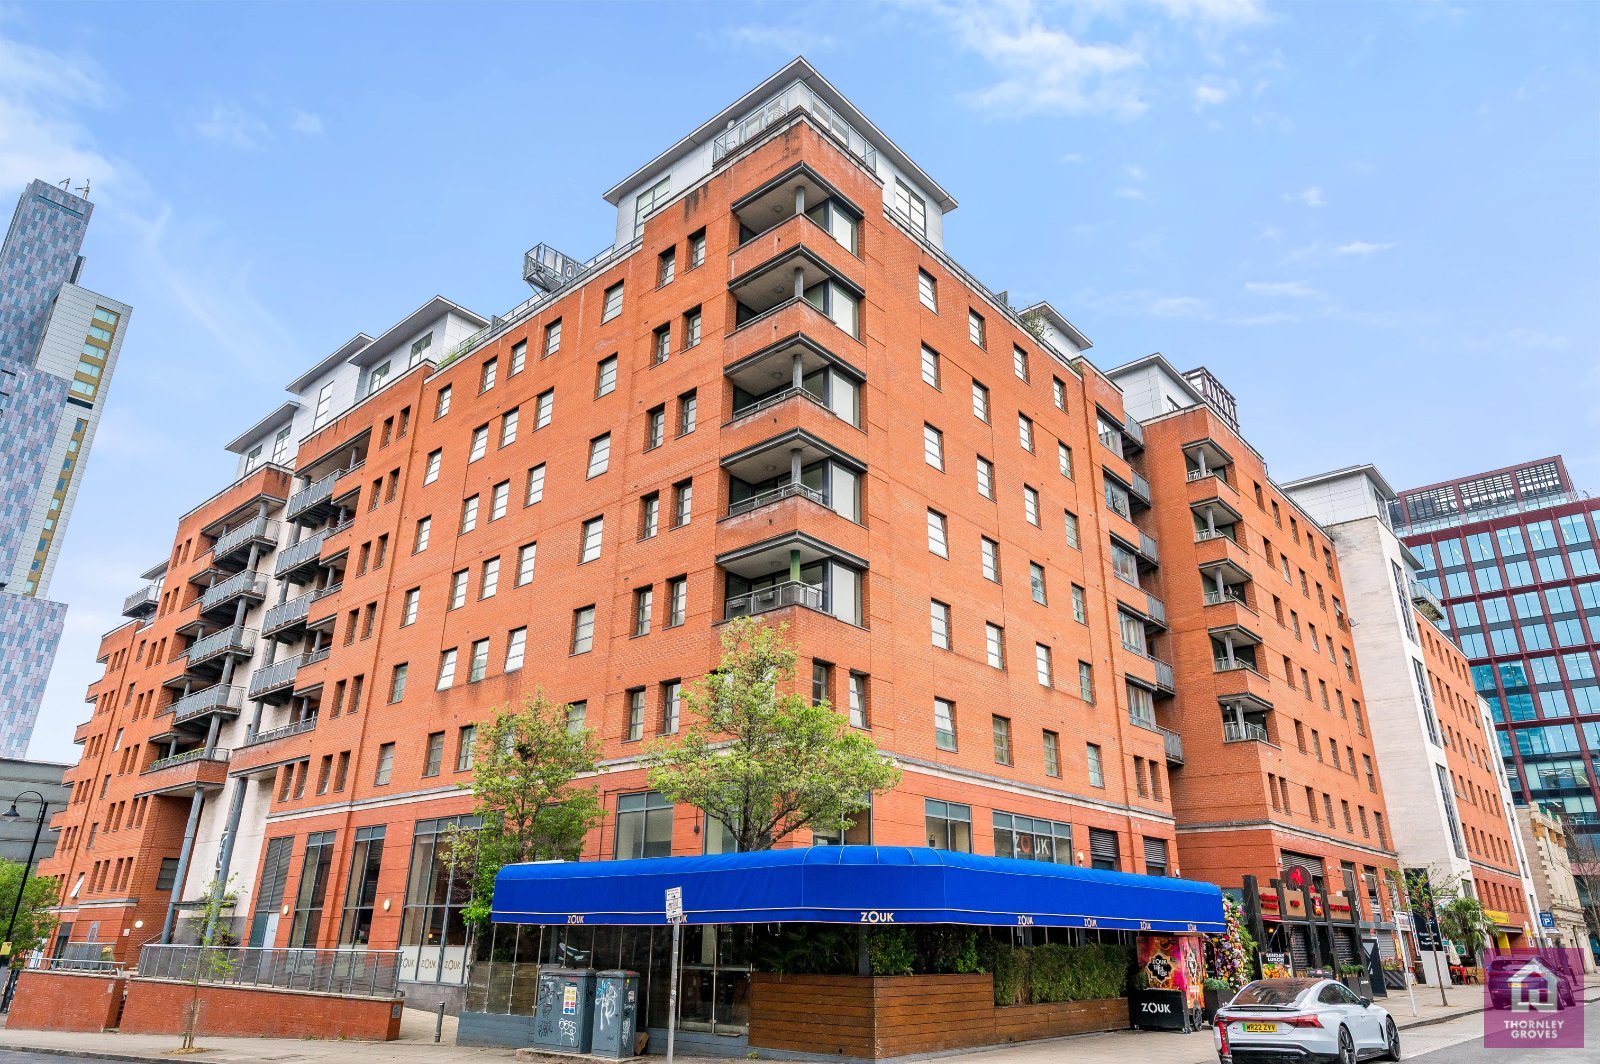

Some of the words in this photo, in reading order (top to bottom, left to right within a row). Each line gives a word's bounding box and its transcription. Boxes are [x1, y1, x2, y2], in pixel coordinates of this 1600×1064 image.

[1014, 834, 1051, 855] ZOUK
[567, 915, 584, 923] ZOUK
[860, 911, 895, 923] ZOUK
[1017, 915, 1033, 925] ZOUK
[1083, 917, 1098, 928] ZOUK
[420, 959, 437, 969] ZOUK
[444, 959, 461, 971] ZOUK
[1141, 1002, 1171, 1014] ZOUK
